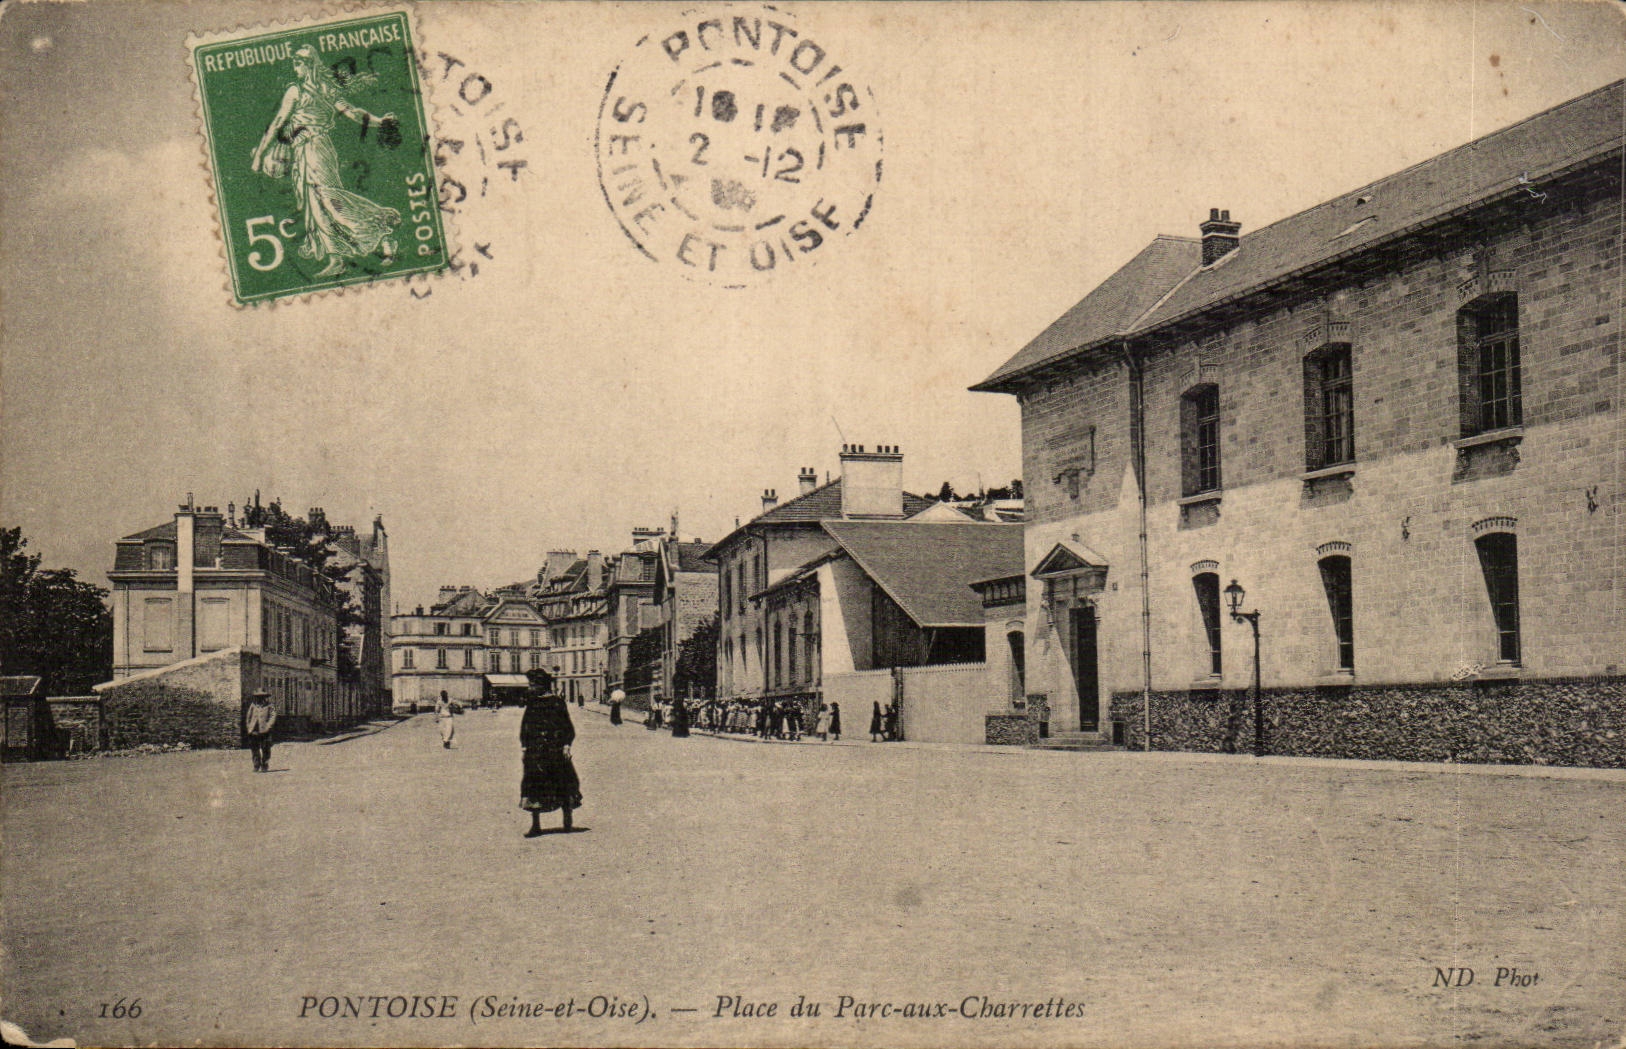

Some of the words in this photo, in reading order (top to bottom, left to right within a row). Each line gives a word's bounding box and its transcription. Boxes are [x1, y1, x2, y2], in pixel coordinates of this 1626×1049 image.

[318, 23, 401, 52] FRANÇAISE
[661, 16, 866, 150] PONTOISE
[609, 95, 666, 236] SEINE
[676, 232, 727, 272] ET
[689, 132, 710, 165] 2
[405, 171, 434, 257] POSTES
